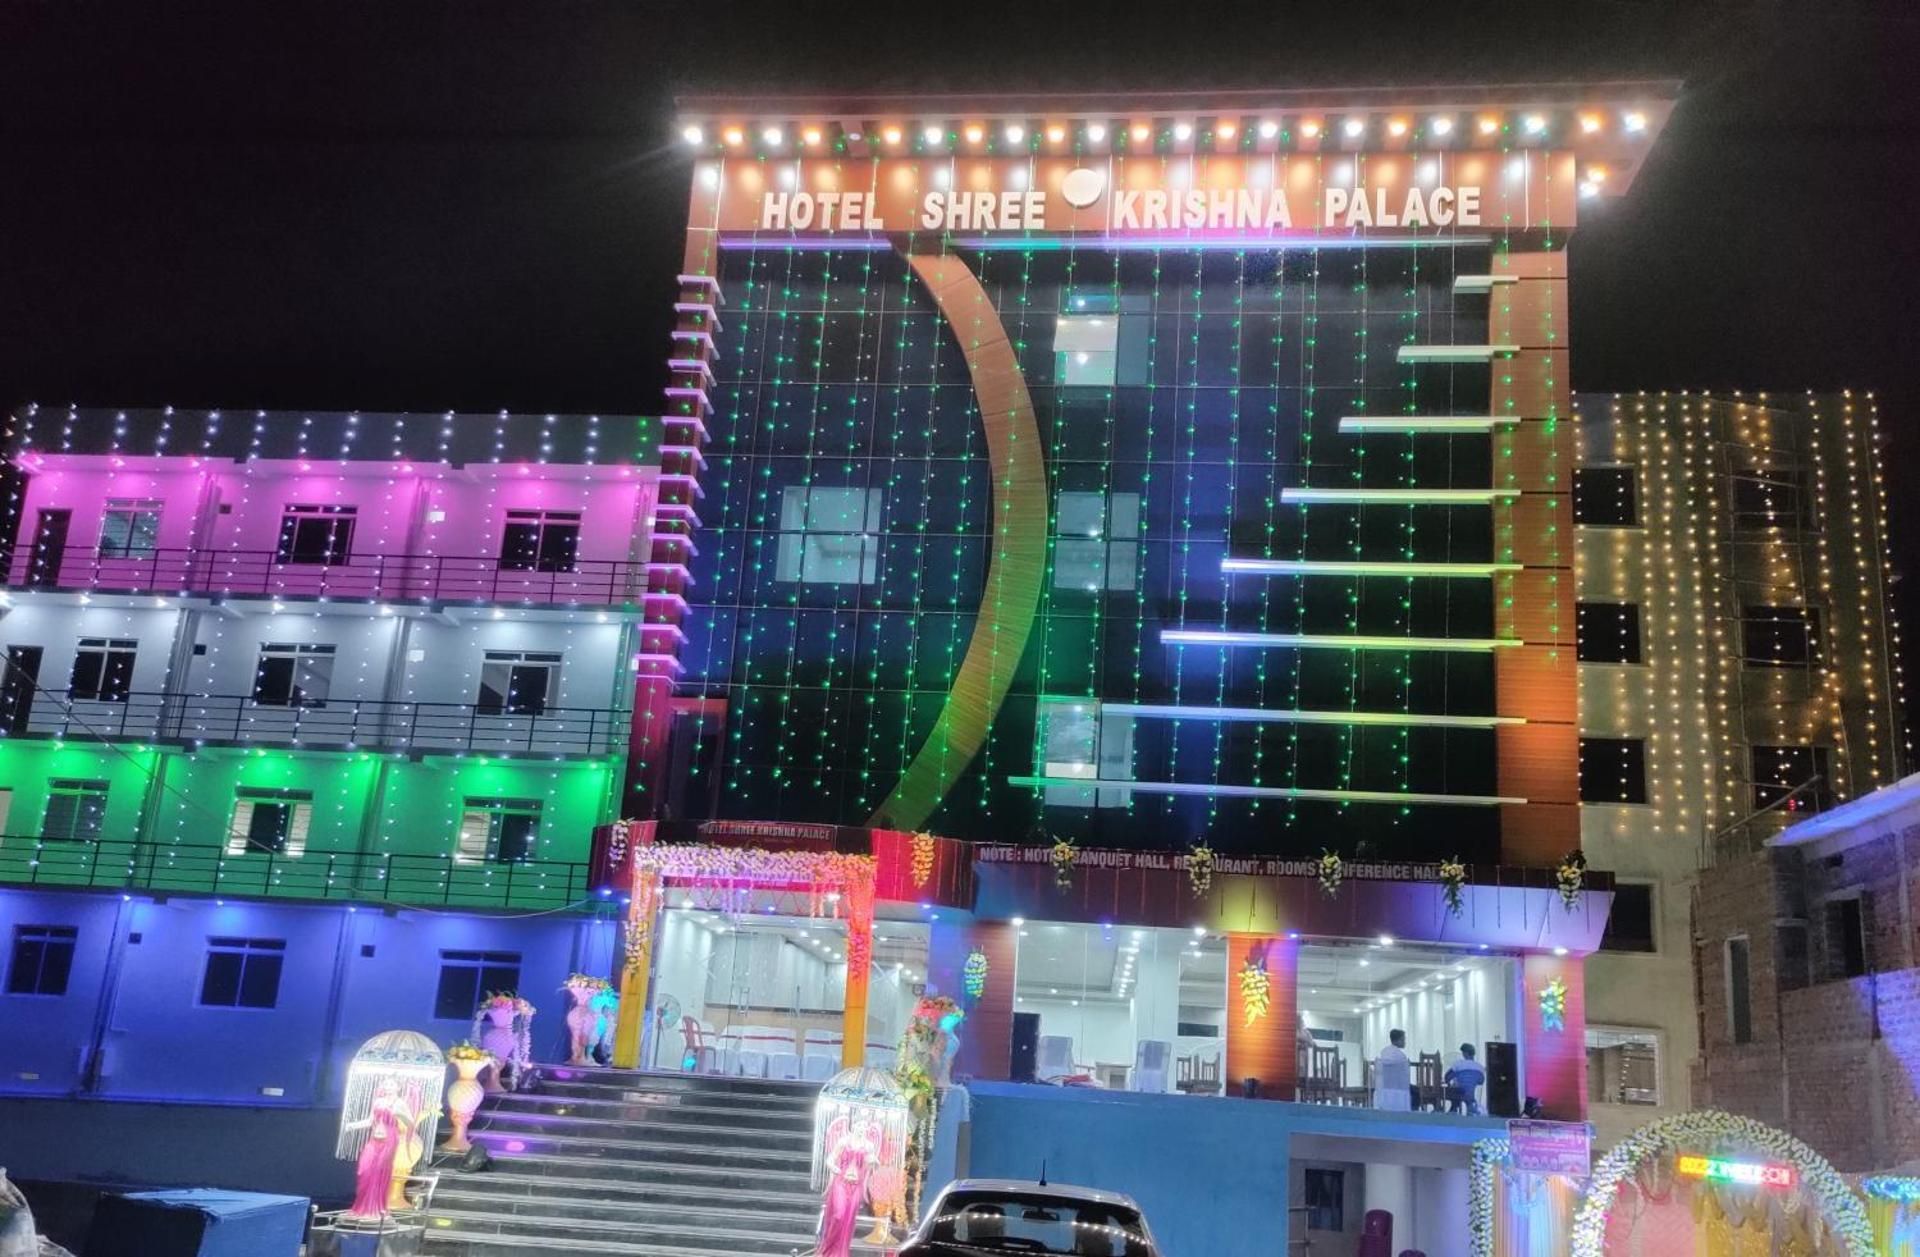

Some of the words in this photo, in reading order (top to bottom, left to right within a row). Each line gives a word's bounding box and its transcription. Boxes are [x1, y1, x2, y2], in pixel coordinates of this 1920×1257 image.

[762, 191, 884, 230] HOTEL
[921, 191, 1047, 231] SHREE
[1113, 188, 1292, 230] KRISHNA
[1325, 186, 1481, 228] PALACE
[797, 828, 831, 840] PALACE
[1024, 847, 1060, 863] HOTE
[1071, 850, 1132, 869] BANQUET
[1174, 854, 1263, 874] REURANT,
[1338, 862, 1410, 879] NFERENCE
